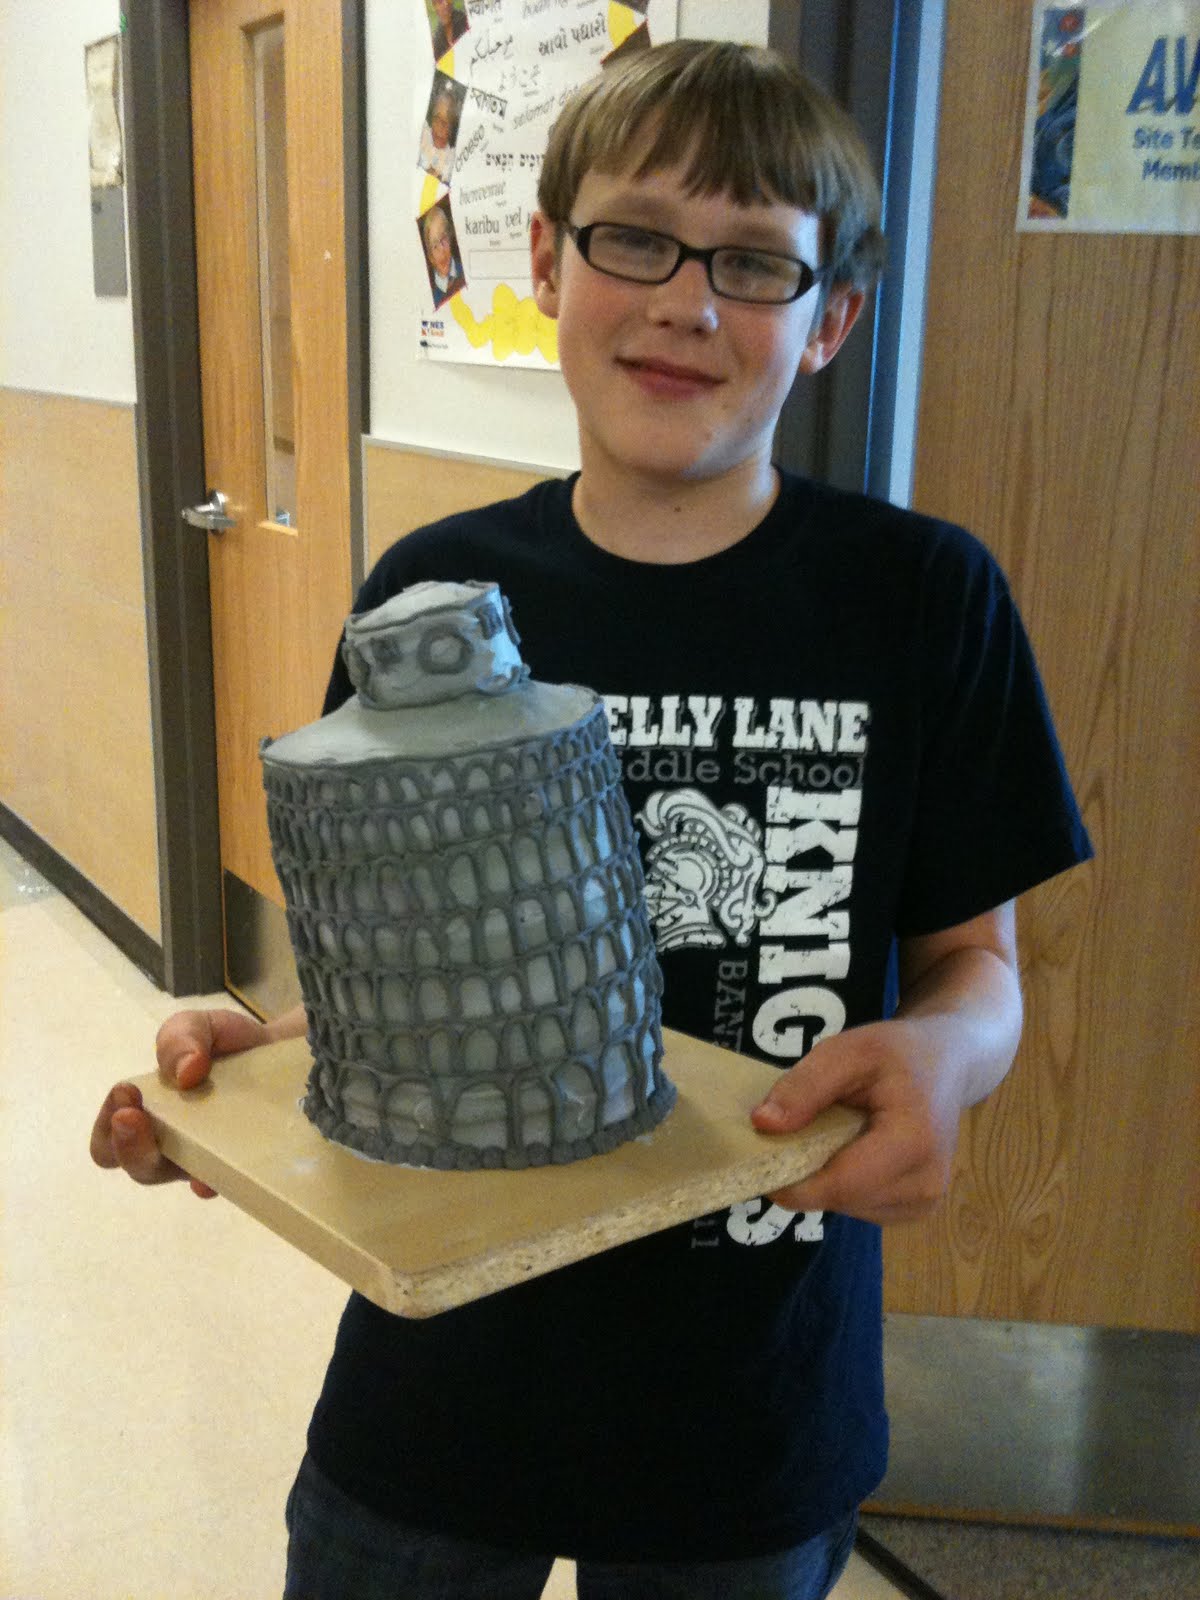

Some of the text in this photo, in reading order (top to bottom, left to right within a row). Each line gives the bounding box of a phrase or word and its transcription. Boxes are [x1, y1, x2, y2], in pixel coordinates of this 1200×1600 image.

[1133, 126, 1174, 150] Site
[464, 214, 500, 235] karibu
[603, 694, 869, 753] ELLY LANE
[619, 750, 864, 788] ddle School
[713, 959, 748, 1053] BAN
